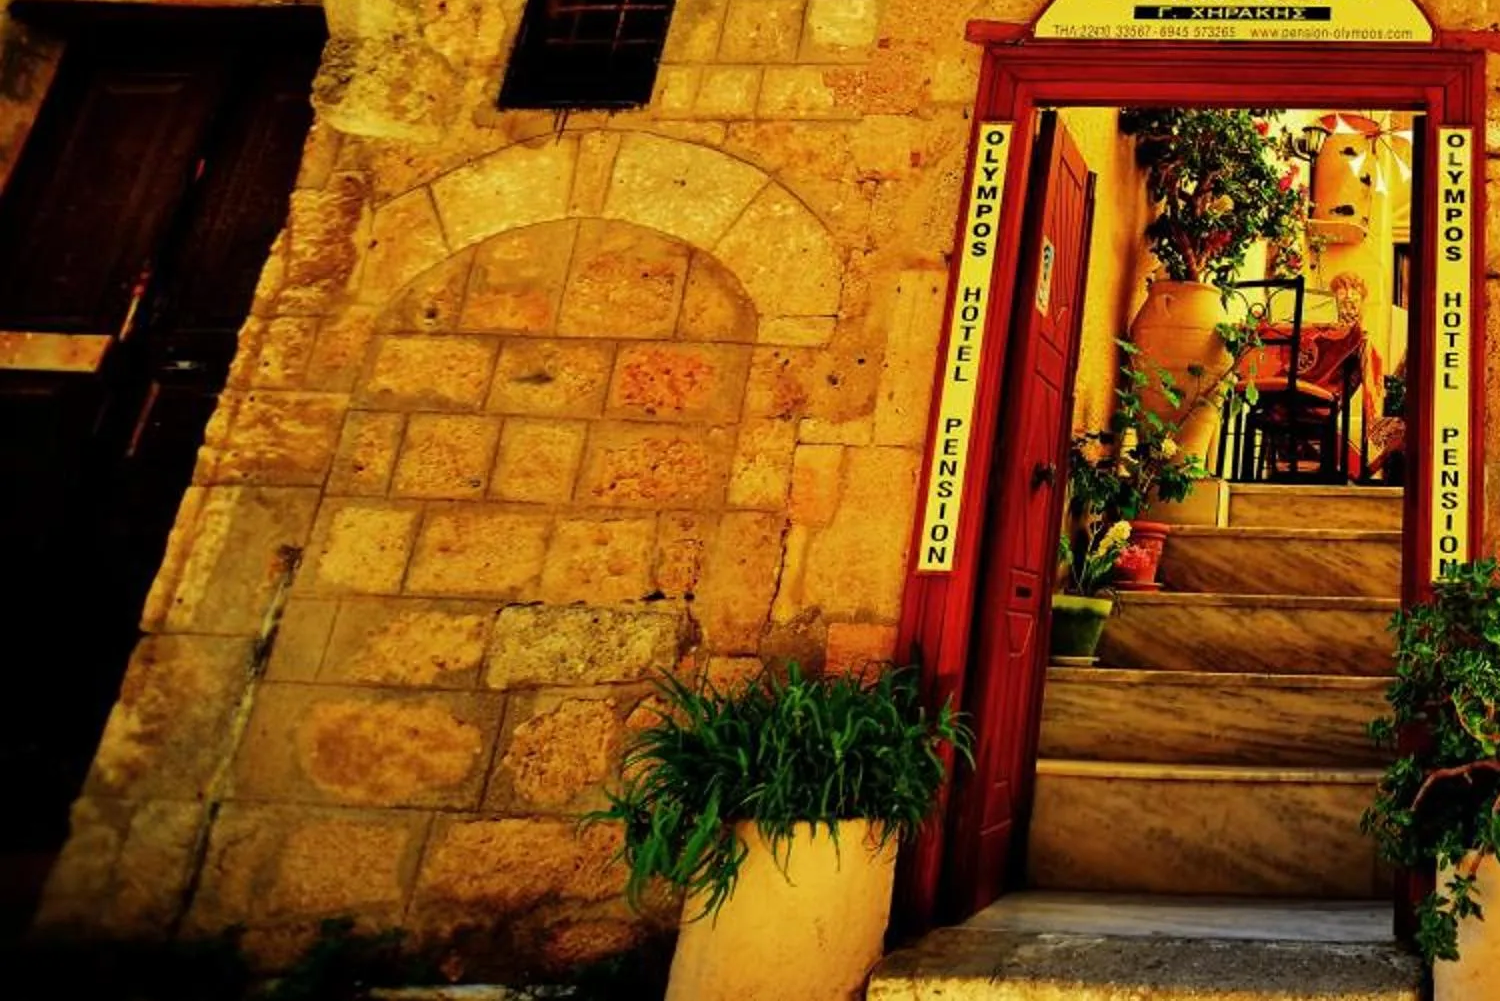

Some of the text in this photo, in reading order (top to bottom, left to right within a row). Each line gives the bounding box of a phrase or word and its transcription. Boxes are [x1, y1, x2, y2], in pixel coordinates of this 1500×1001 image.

[1157, 7, 1307, 20] Γ. ΧΗΡΑΚΗΣ
[1443, 134, 1466, 262] OLYMPOS
[927, 130, 1005, 564] OLYMPOS HOTEL PENSION
[1443, 292, 1462, 389] HOTEL
